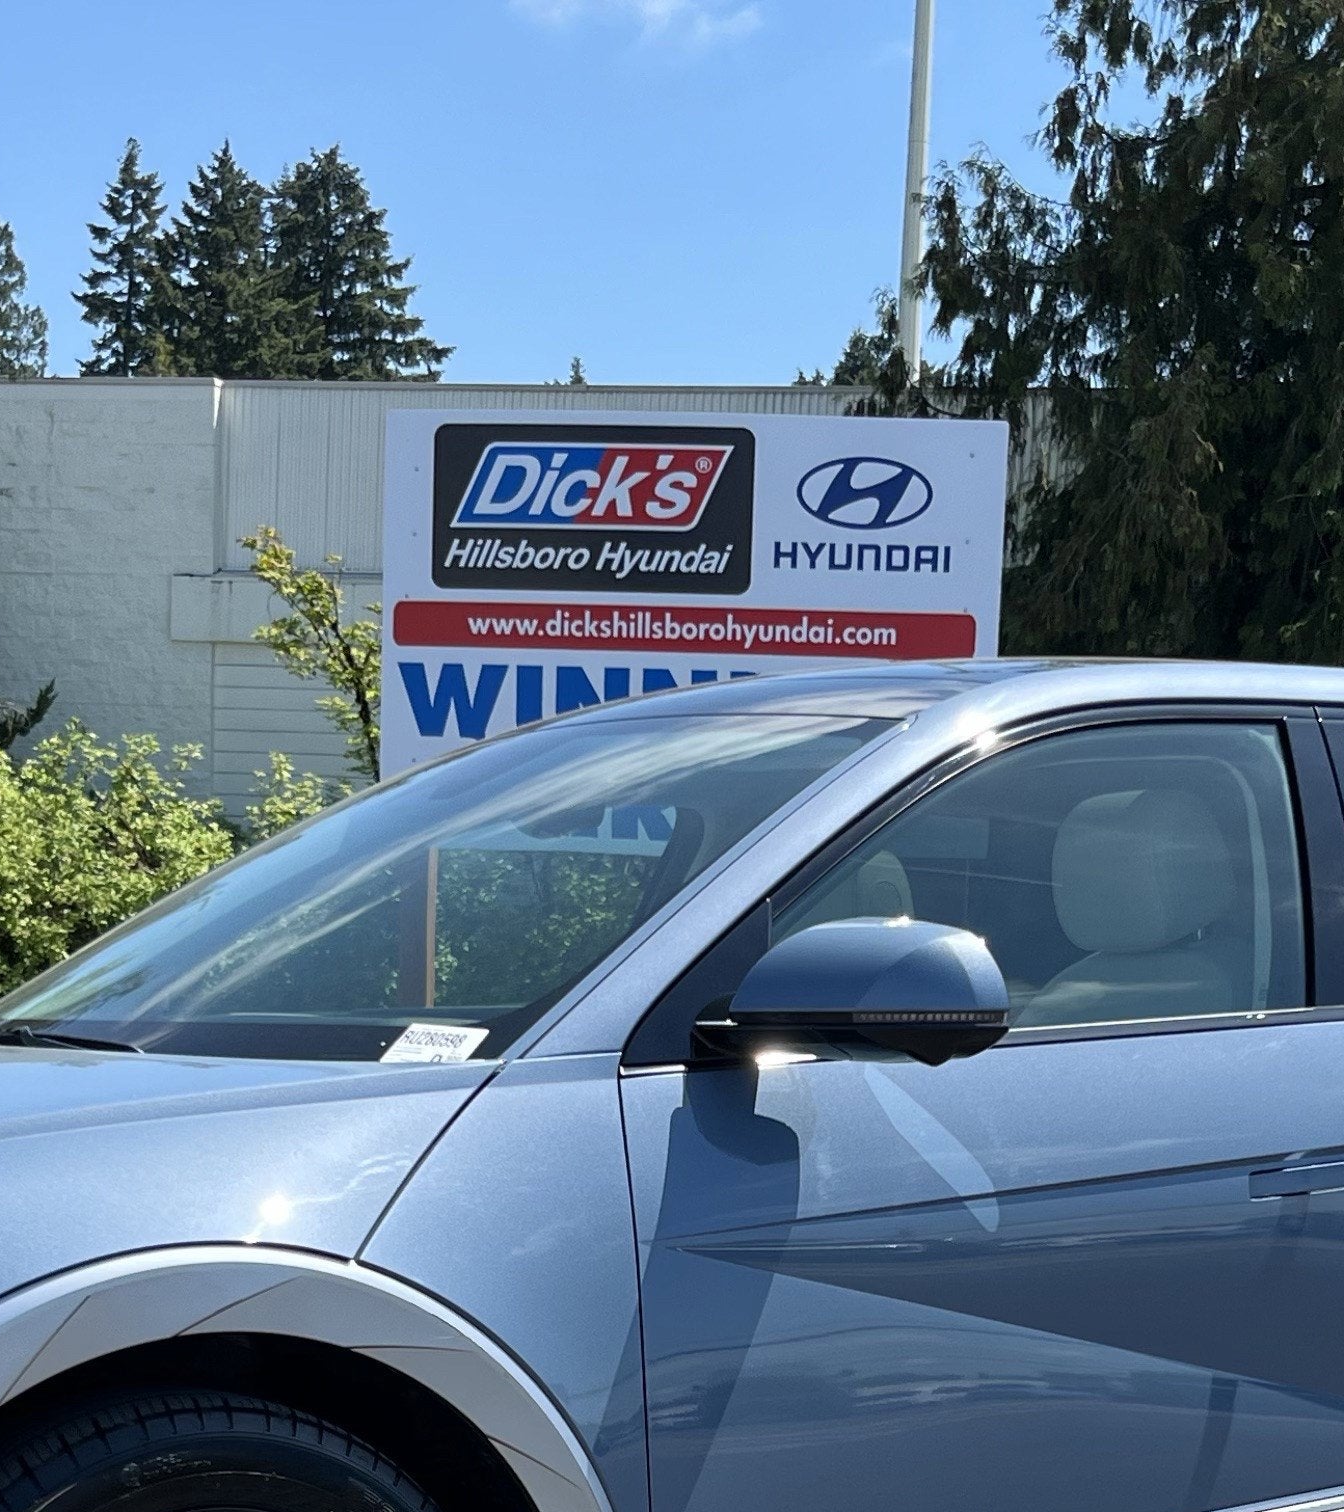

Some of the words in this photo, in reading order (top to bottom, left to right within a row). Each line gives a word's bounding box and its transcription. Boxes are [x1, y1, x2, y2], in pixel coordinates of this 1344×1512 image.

[470, 451, 697, 521] Dick's
[444, 538, 590, 570] Hillsboro
[594, 543, 733, 580] Hyundai
[773, 540, 951, 574] HYUNDAI
[467, 611, 898, 650] www.dickshillsborohyundai.com
